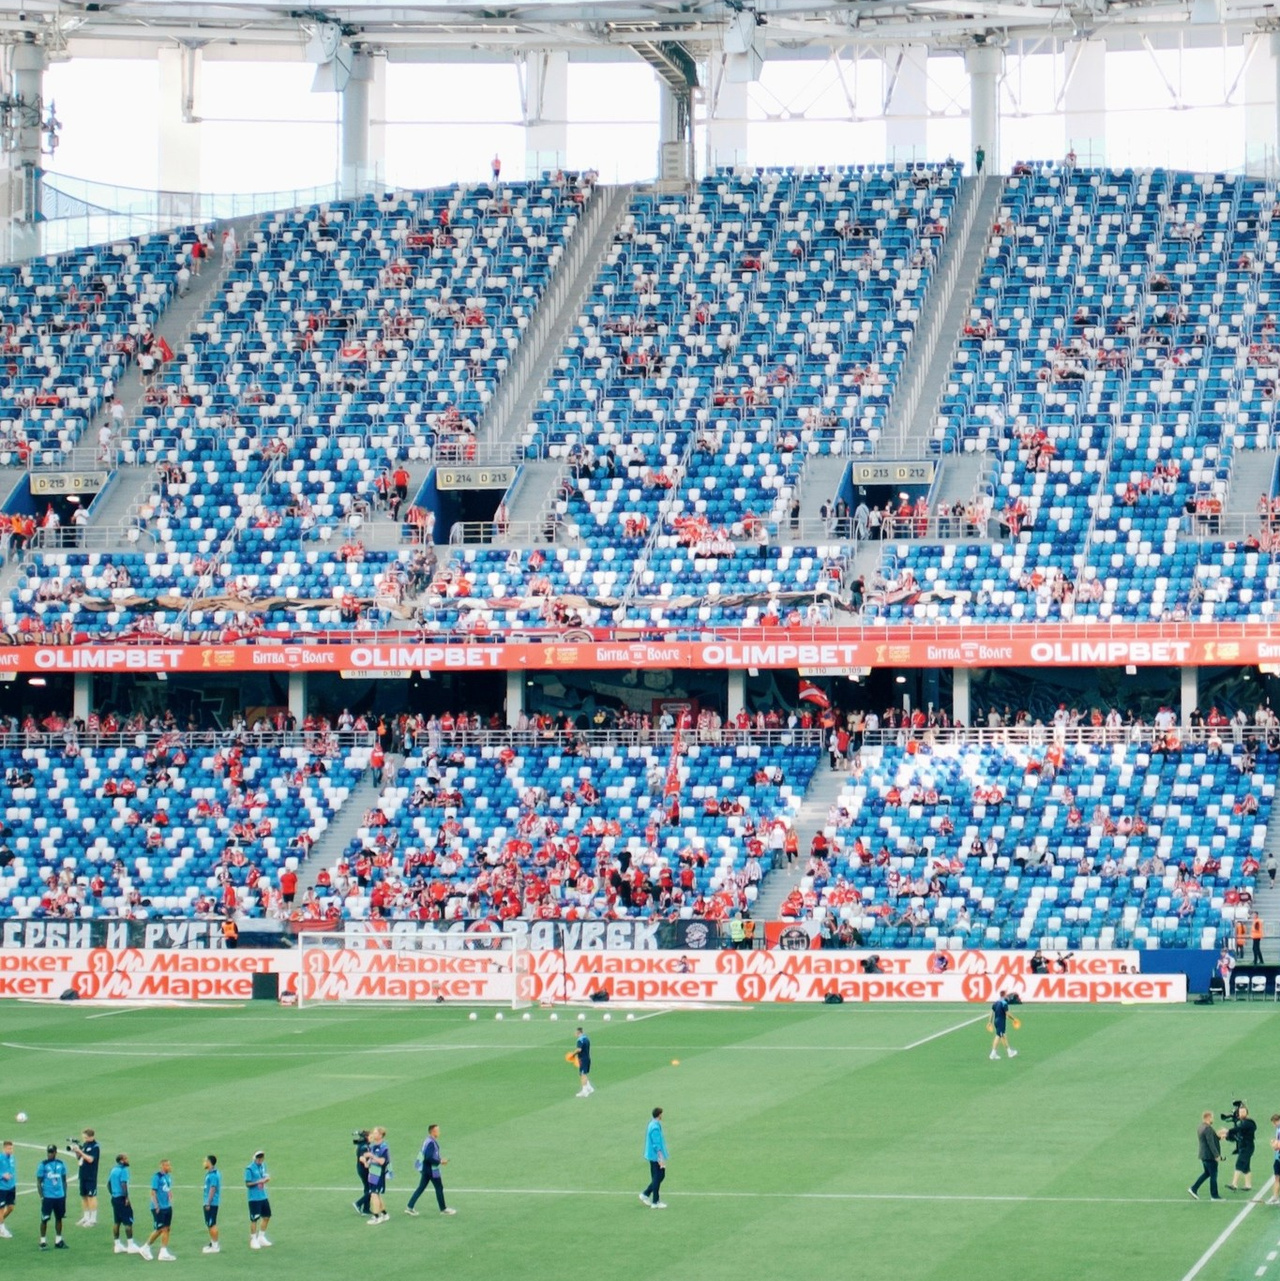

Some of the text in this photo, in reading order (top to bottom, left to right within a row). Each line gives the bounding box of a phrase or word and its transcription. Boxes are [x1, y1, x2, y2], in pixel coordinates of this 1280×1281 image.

[39, 478, 99, 488] D 215 D 214
[445, 473, 507, 483] D 214 D 213
[862, 468, 925, 478] D 213 D 212
[34, 648, 184, 668] OLIMPBET
[350, 647, 503, 667] OLIMPBET
[702, 645, 858, 664] OLIMPBET
[1030, 641, 1192, 662] OLIMPBET
[2, 922, 91, 948] СРБИ
[106, 922, 128, 948] И
[149, 953, 275, 972] Маркет
[366, 953, 493, 973] Маркет
[785, 954, 911, 973] Марет
[138, 976, 252, 999] Марке
[354, 976, 488, 1000] Маркет
[583, 977, 718, 1001] Маркет
[804, 977, 944, 1002] Маркет
[1032, 977, 1173, 1002] Маркет
